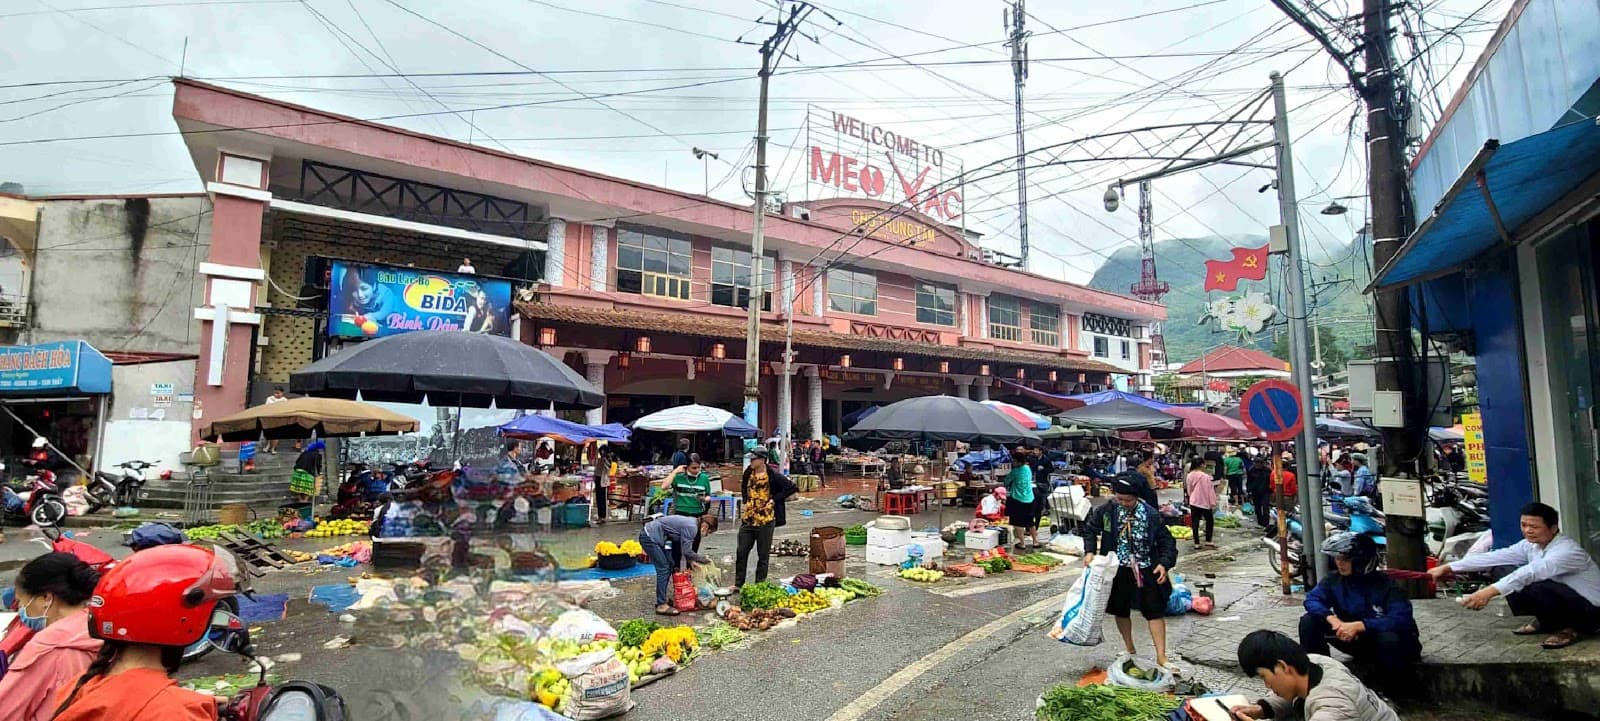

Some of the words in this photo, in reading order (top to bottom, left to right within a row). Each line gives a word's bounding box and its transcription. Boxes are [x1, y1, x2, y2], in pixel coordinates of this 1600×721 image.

[832, 111, 919, 159] WELCOME
[922, 144, 944, 167] TO
[23, 347, 47, 370] BÁCH
